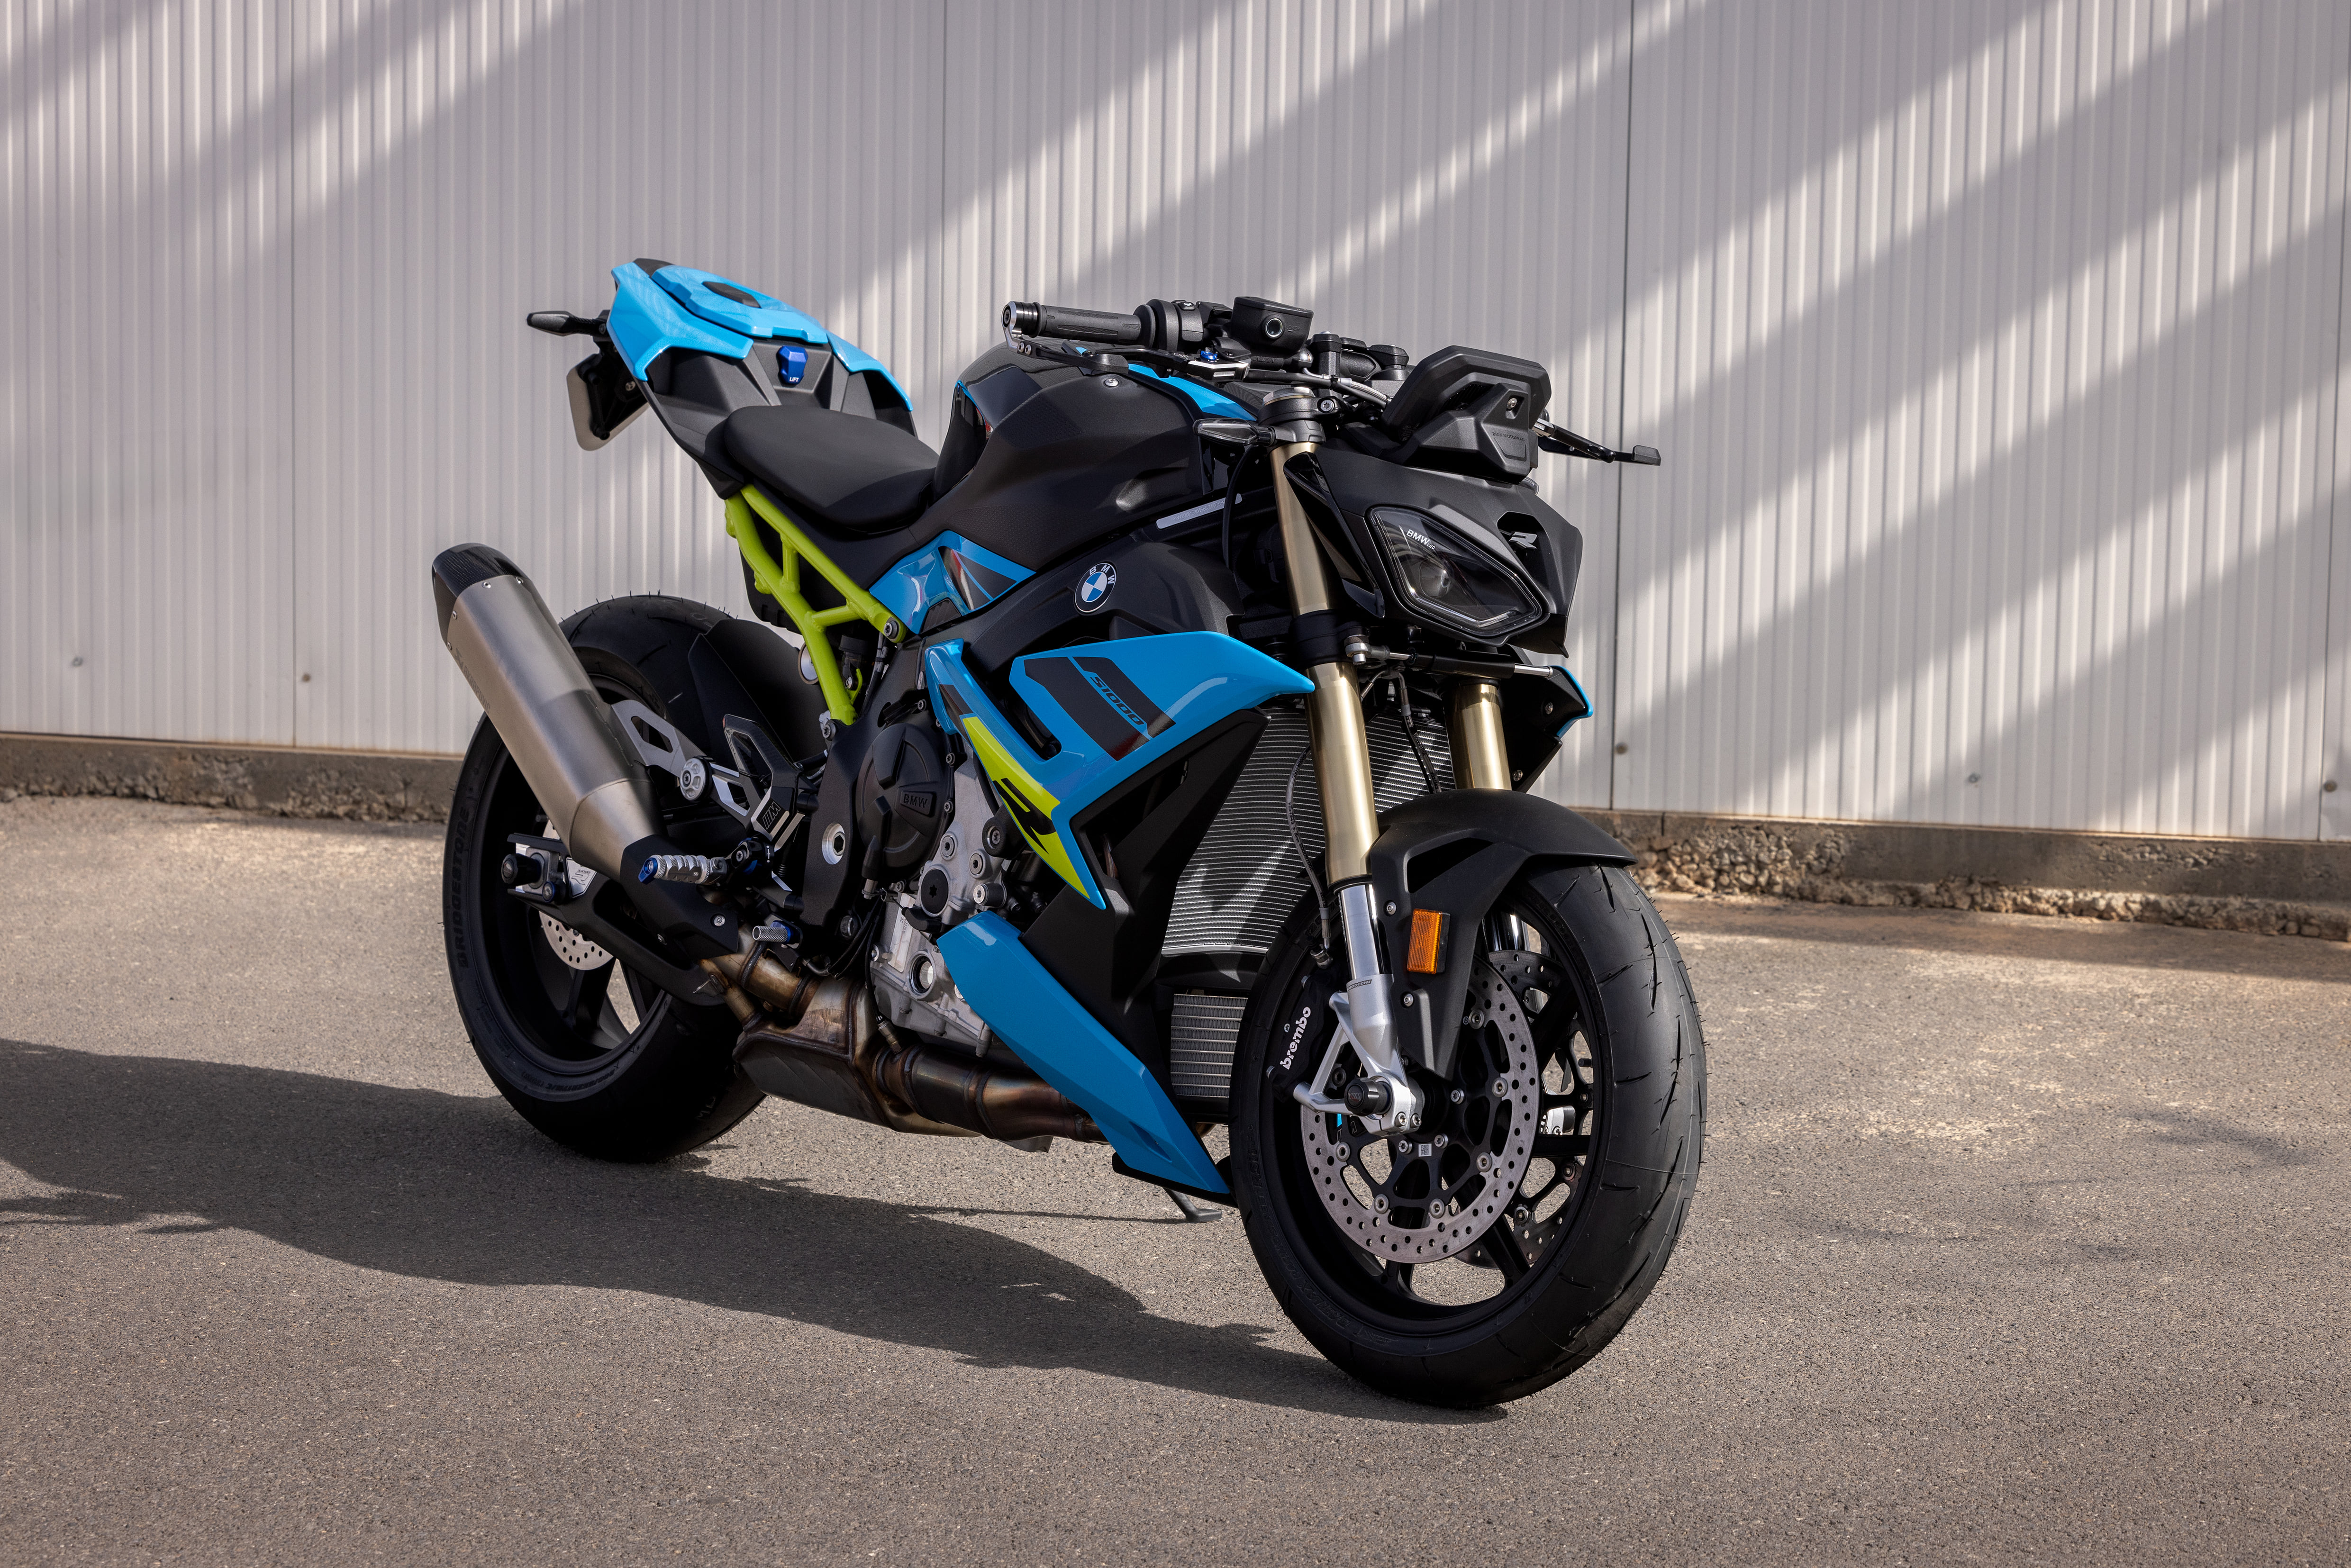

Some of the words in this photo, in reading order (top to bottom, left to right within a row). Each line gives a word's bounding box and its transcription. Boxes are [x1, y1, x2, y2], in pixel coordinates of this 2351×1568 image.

[1503, 433, 1525, 442] MOTORRAD
[1406, 529, 1430, 545] BMW
[1089, 564, 1115, 584] BMW
[1089, 677, 1144, 725] S1000
[904, 794, 927, 808] BMW
[451, 807, 469, 969] BRIDGESTONE
[1280, 1006, 1311, 1070] brembo
